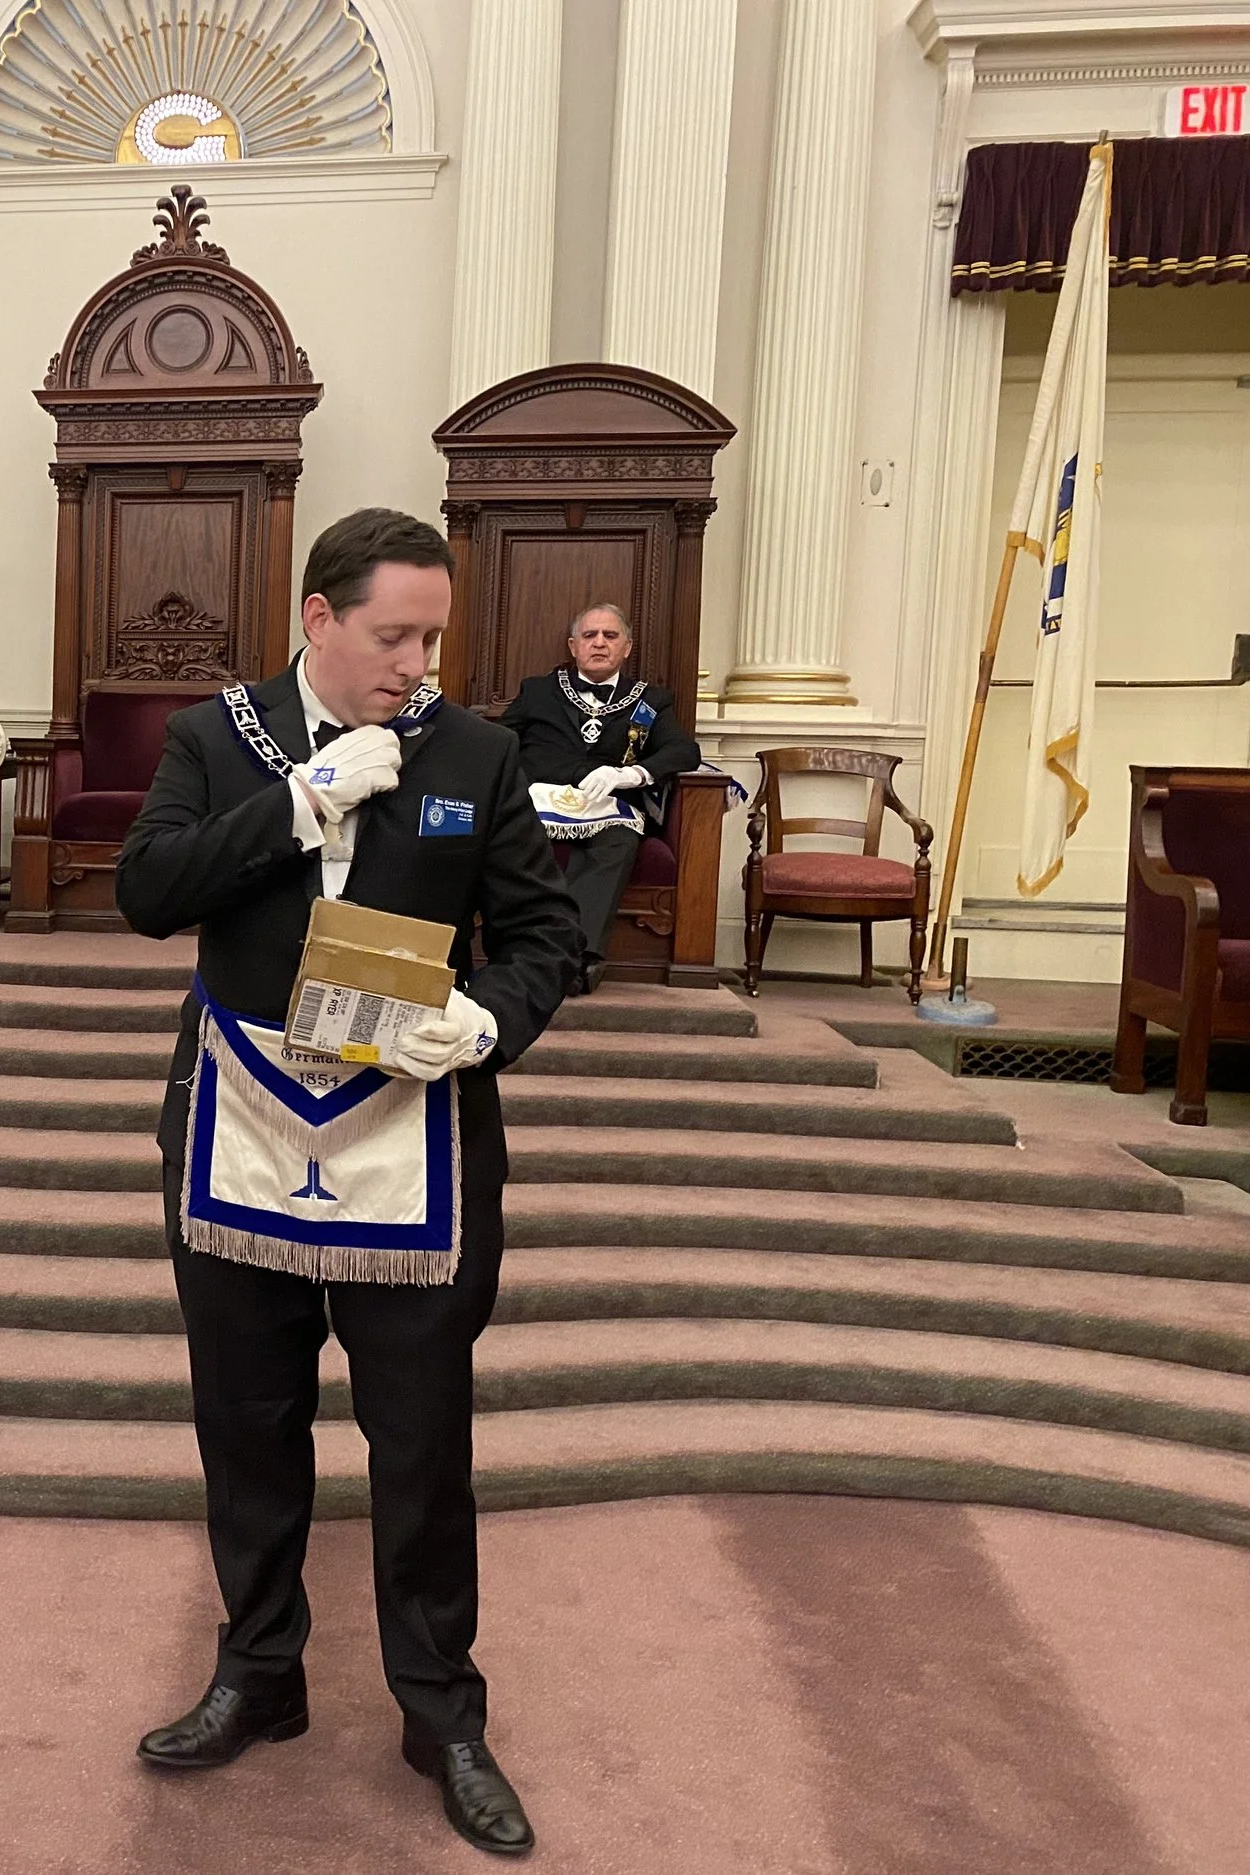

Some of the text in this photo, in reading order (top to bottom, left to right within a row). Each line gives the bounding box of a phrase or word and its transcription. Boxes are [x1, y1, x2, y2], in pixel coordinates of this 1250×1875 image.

[135, 94, 226, 164] G
[1181, 86, 1247, 132] EXIT
[300, 1072, 340, 1087] 1854
